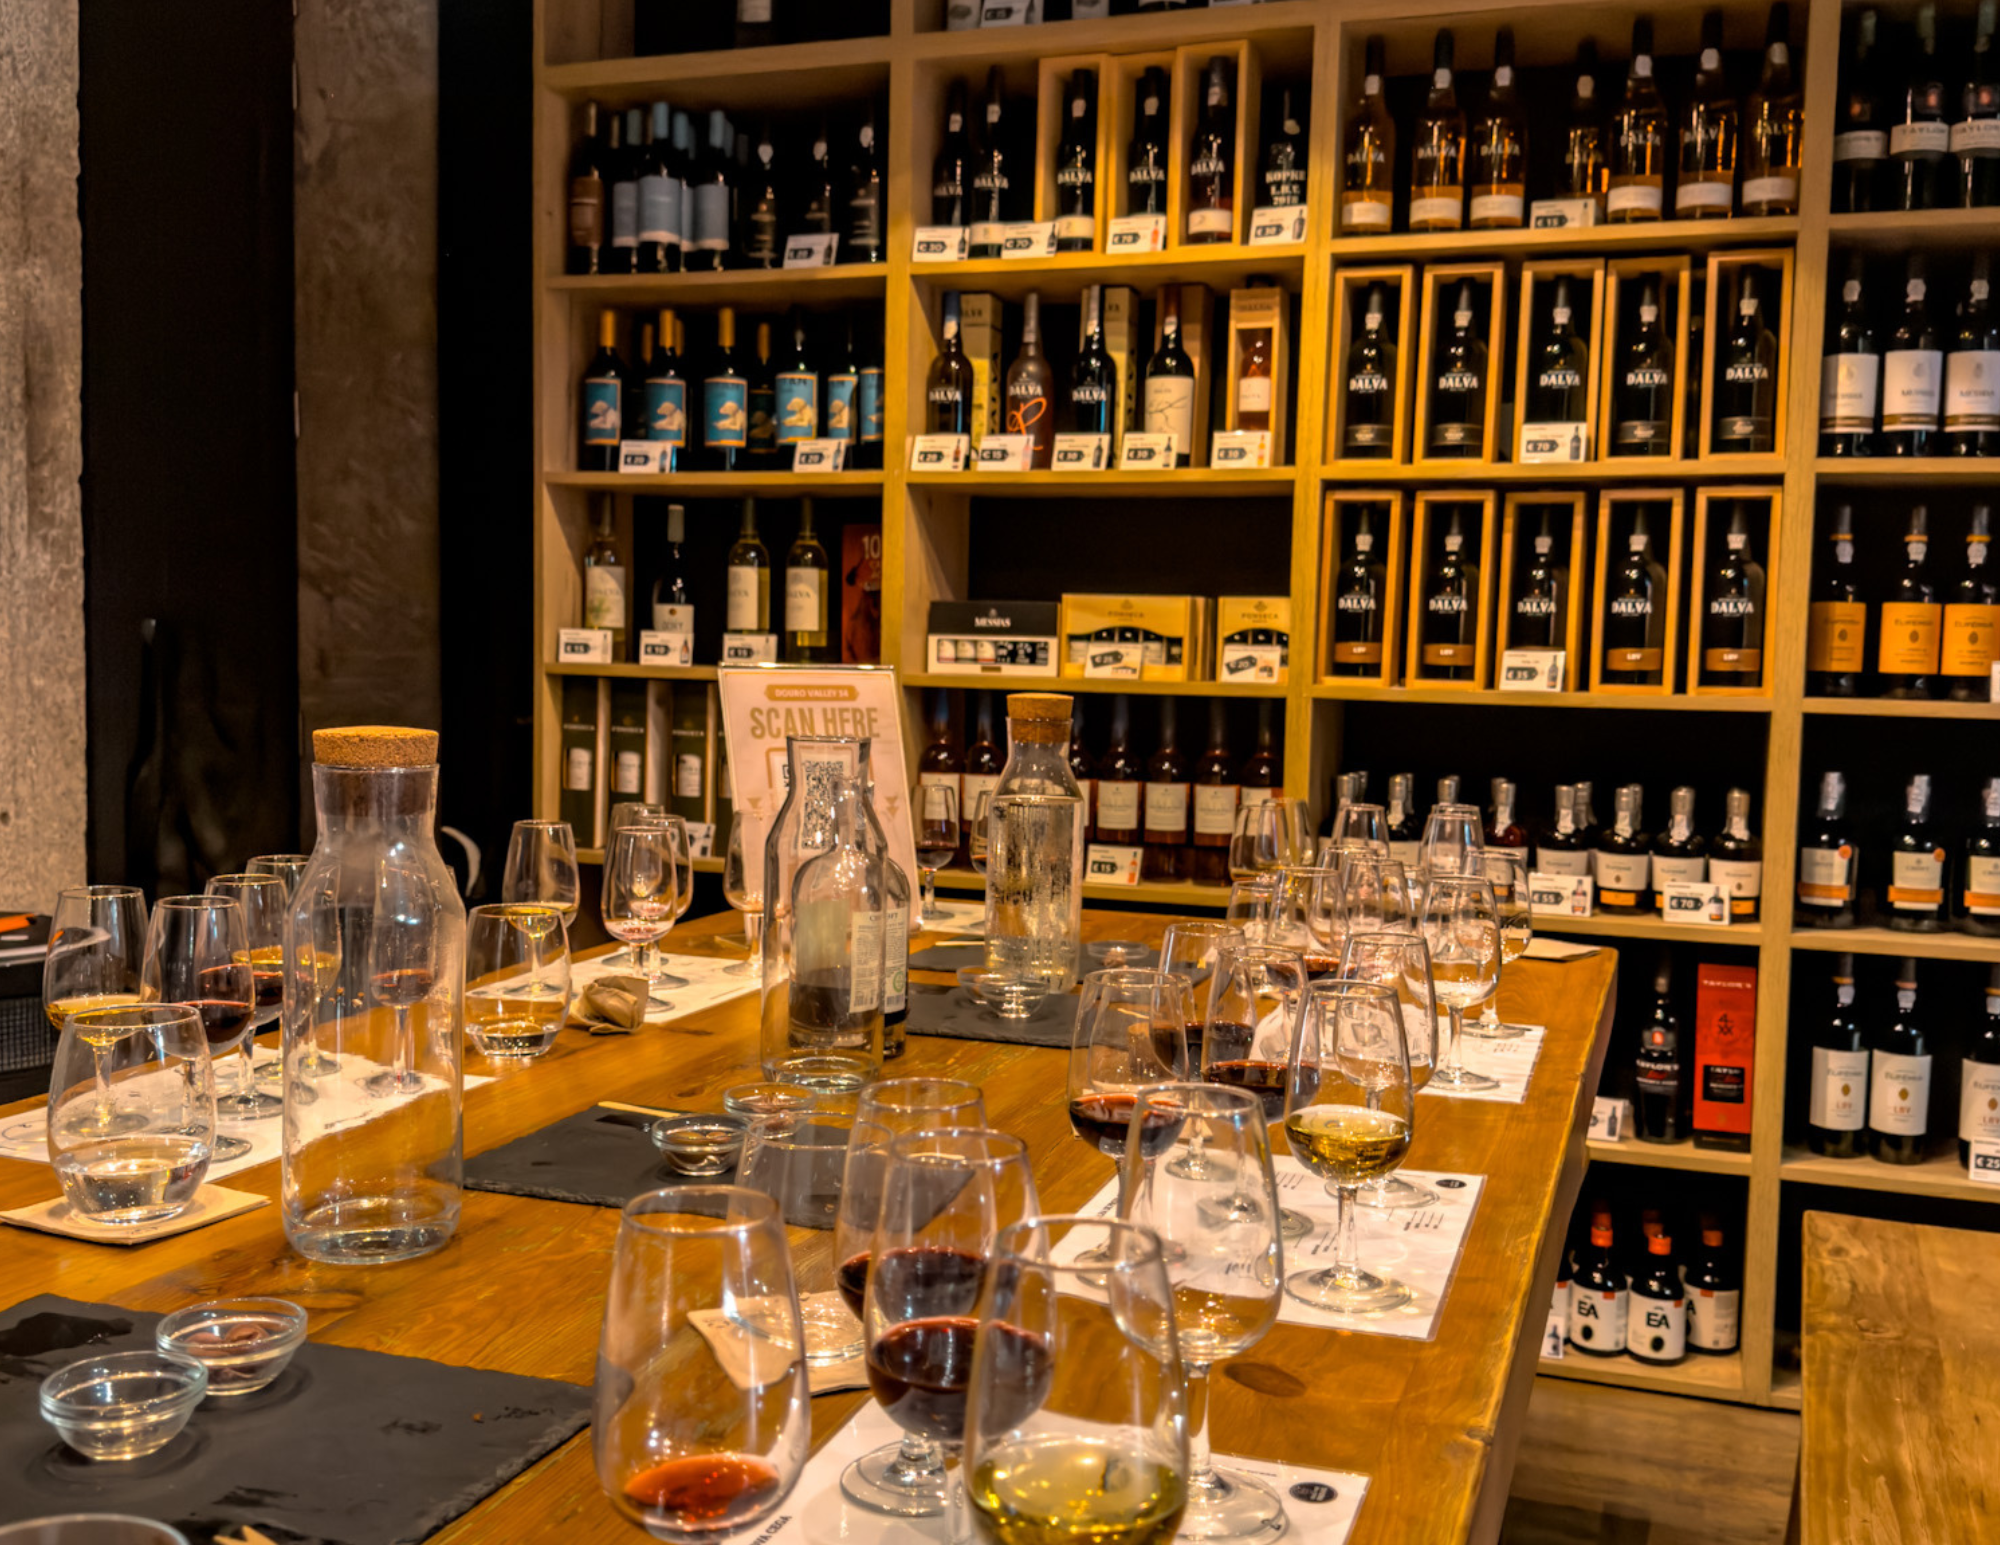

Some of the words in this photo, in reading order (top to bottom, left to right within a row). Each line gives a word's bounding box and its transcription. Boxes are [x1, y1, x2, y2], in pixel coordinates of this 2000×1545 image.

[1539, 374, 1581, 387] DALVA
[1626, 373, 1668, 386] DALVA
[1725, 367, 1769, 381] DALVA
[1008, 383, 1043, 396] DALVA
[1349, 378, 1388, 391] DALVA
[1438, 376, 1479, 390] DALVA
[1072, 389, 1107, 401] DALVA
[1338, 598, 1376, 610] DALVA
[1428, 598, 1468, 611] DALVA
[1517, 601, 1557, 613] DALVA
[1611, 601, 1652, 614] DALVA
[1710, 601, 1755, 614] DALVA
[774, 689, 806, 697] DOURO
[807, 689, 837, 697] VALLEY
[749, 707, 816, 739] SCAN
[822, 706, 880, 737] HERE
[1680, 899, 1694, 909] 70
